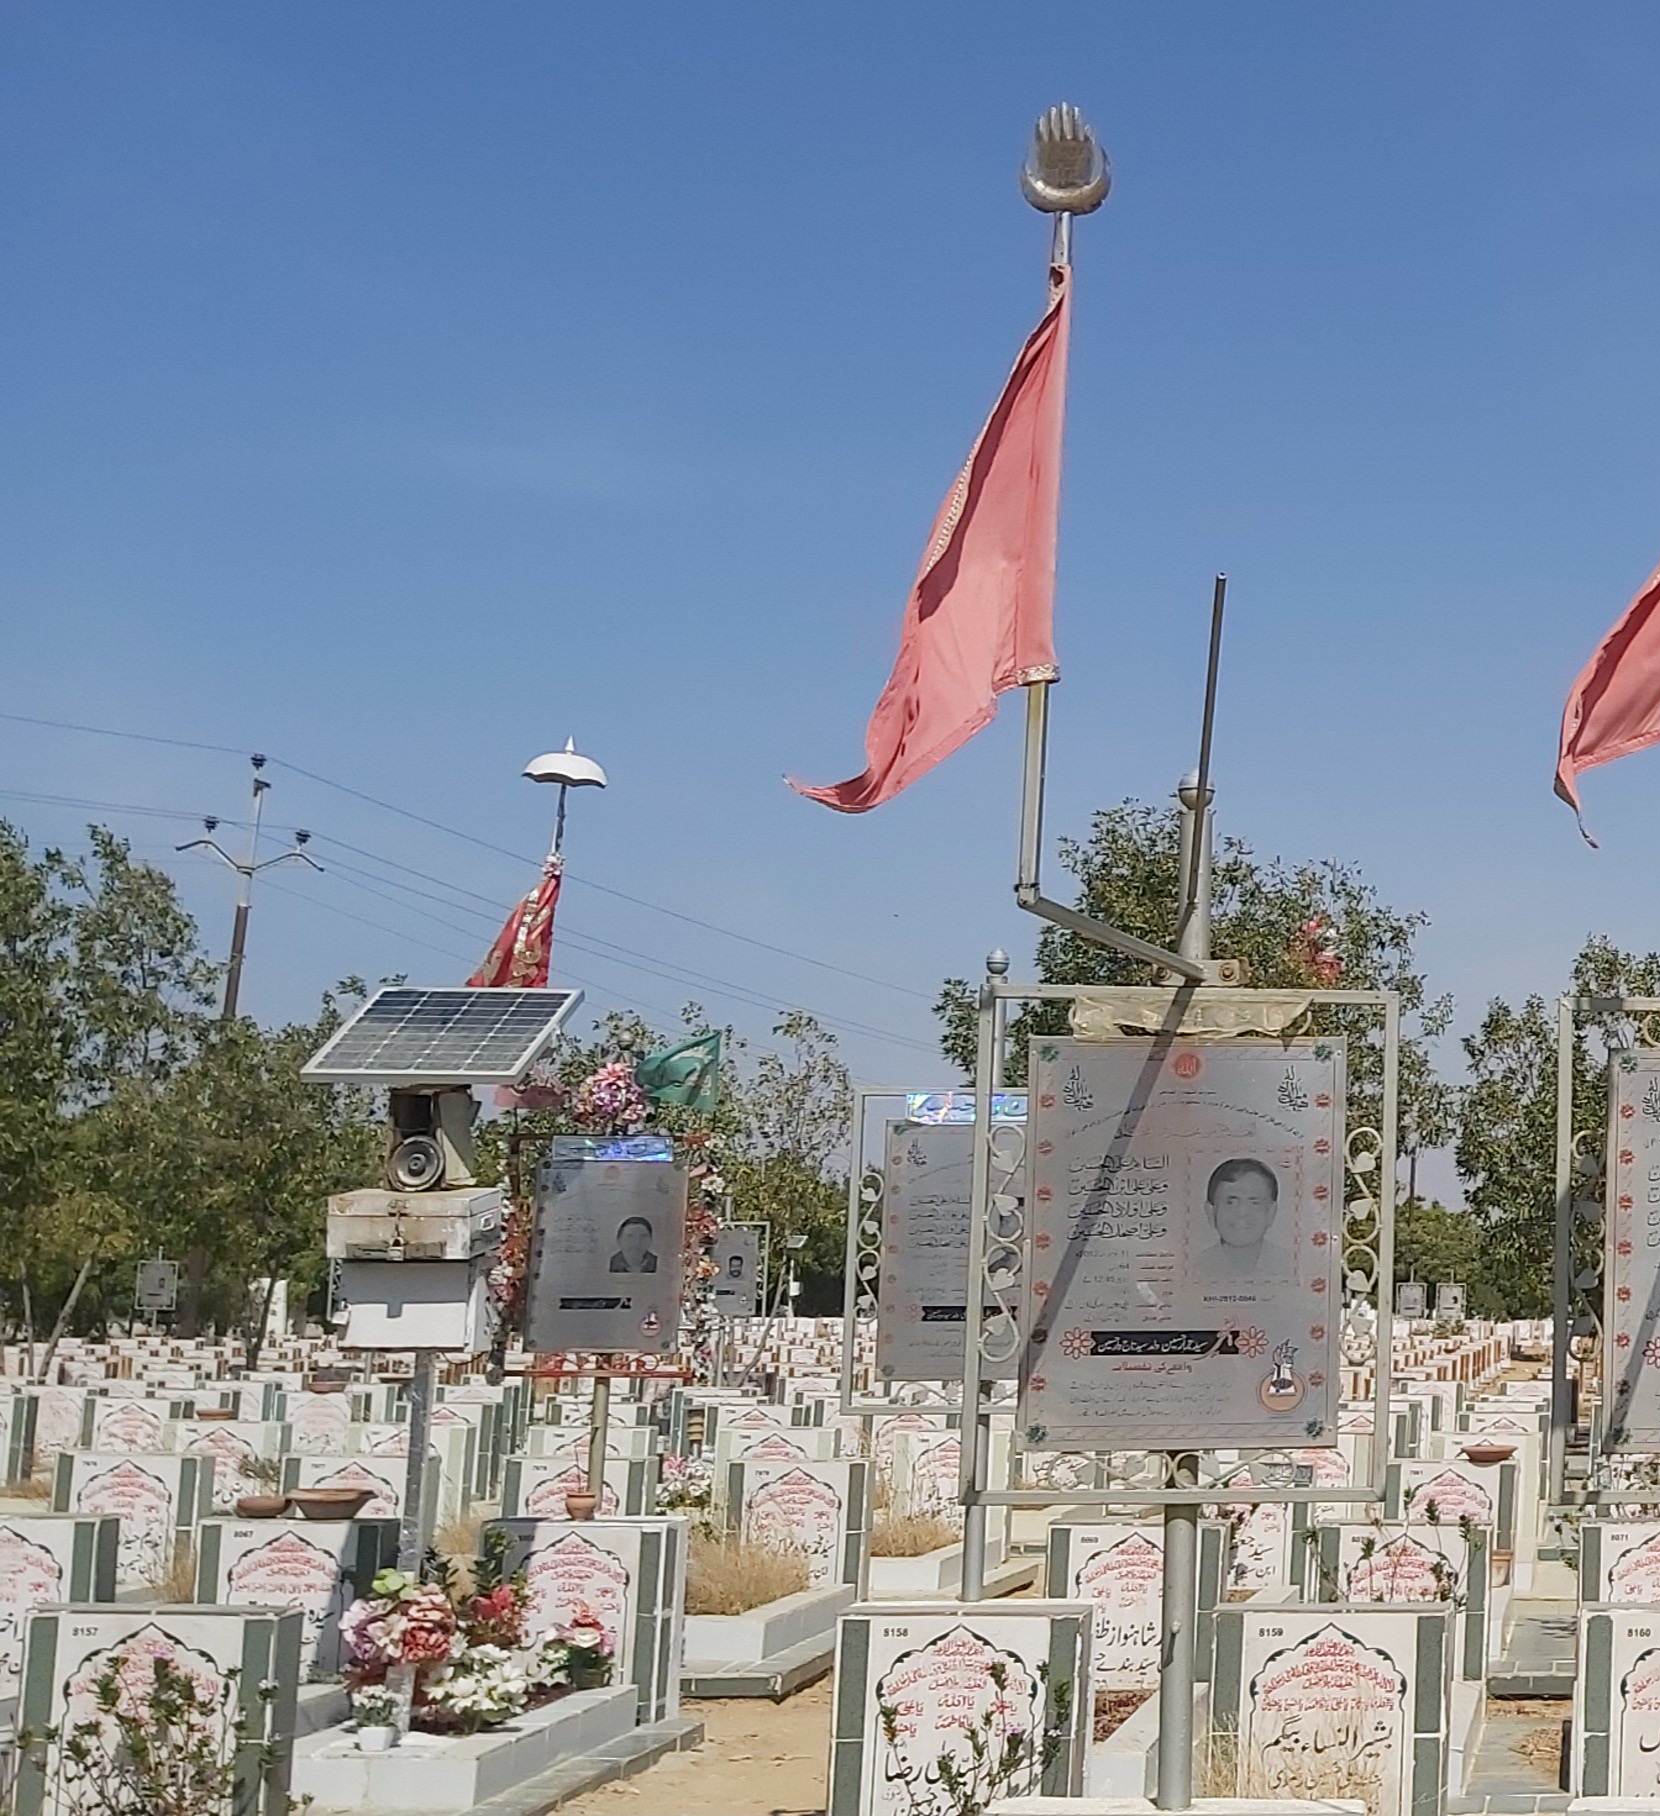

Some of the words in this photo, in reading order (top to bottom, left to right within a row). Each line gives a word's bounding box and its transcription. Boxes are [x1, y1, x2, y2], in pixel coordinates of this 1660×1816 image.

[71, 1627, 99, 1637] 8157
[883, 1627, 909, 1638] 8158
[1258, 1627, 1284, 1638] 8159
[1627, 1628, 1651, 1638] 8160
[1261, 1714, 1302, 1763] بیگم
[885, 1750, 924, 1786] رضا
